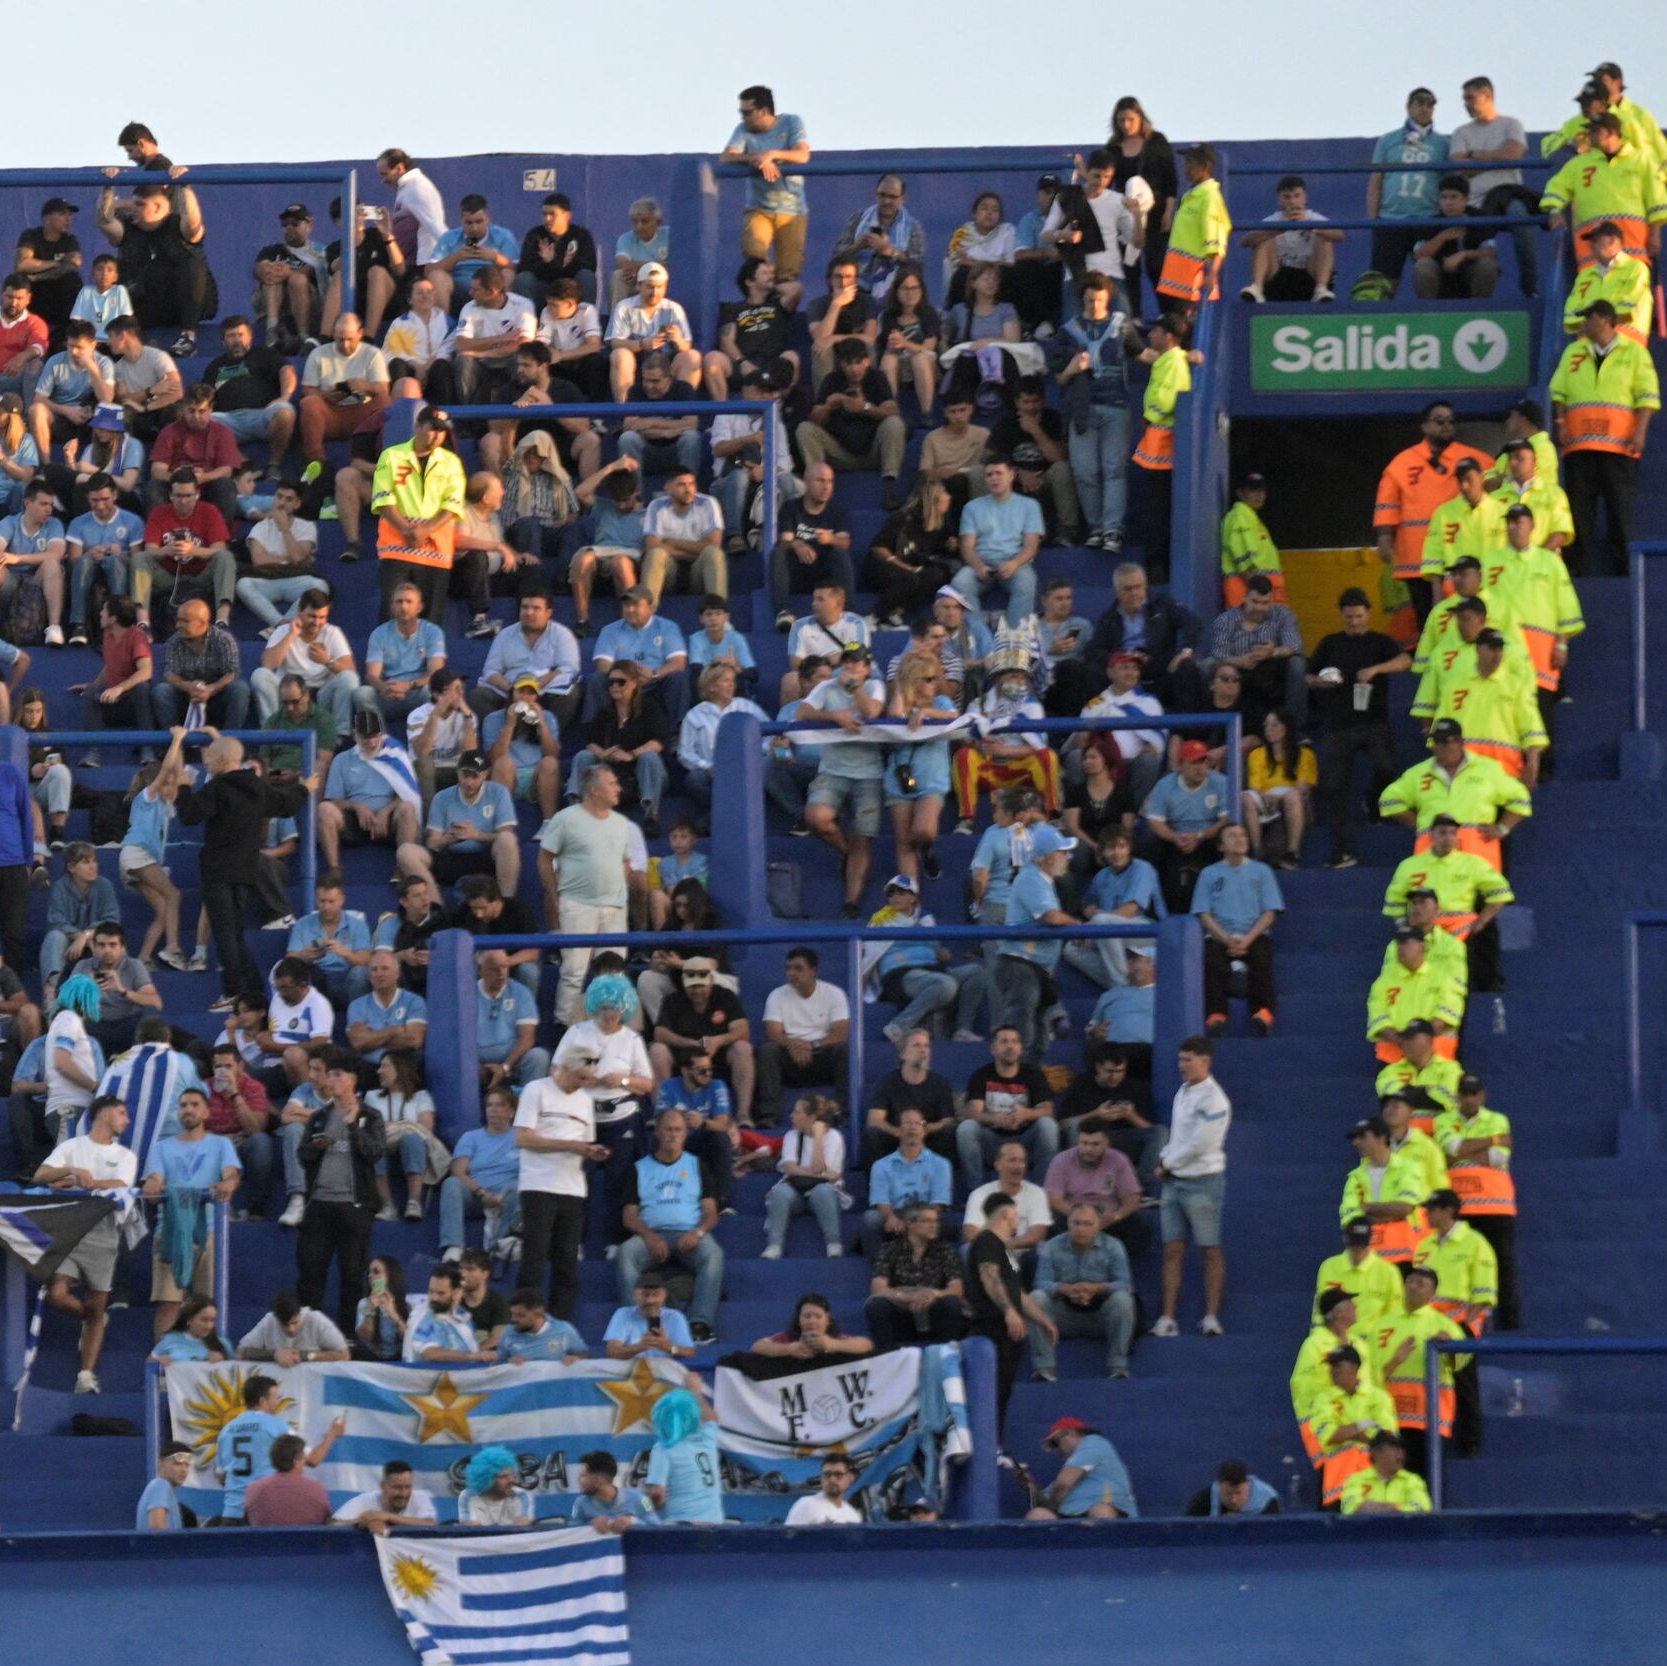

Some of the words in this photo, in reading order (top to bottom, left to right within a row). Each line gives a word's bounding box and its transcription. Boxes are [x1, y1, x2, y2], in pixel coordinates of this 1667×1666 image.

[524, 170, 556, 191] 54
[1272, 324, 1441, 373] Salida
[233, 1435, 253, 1477] 5
[696, 1451, 715, 1488] 9
